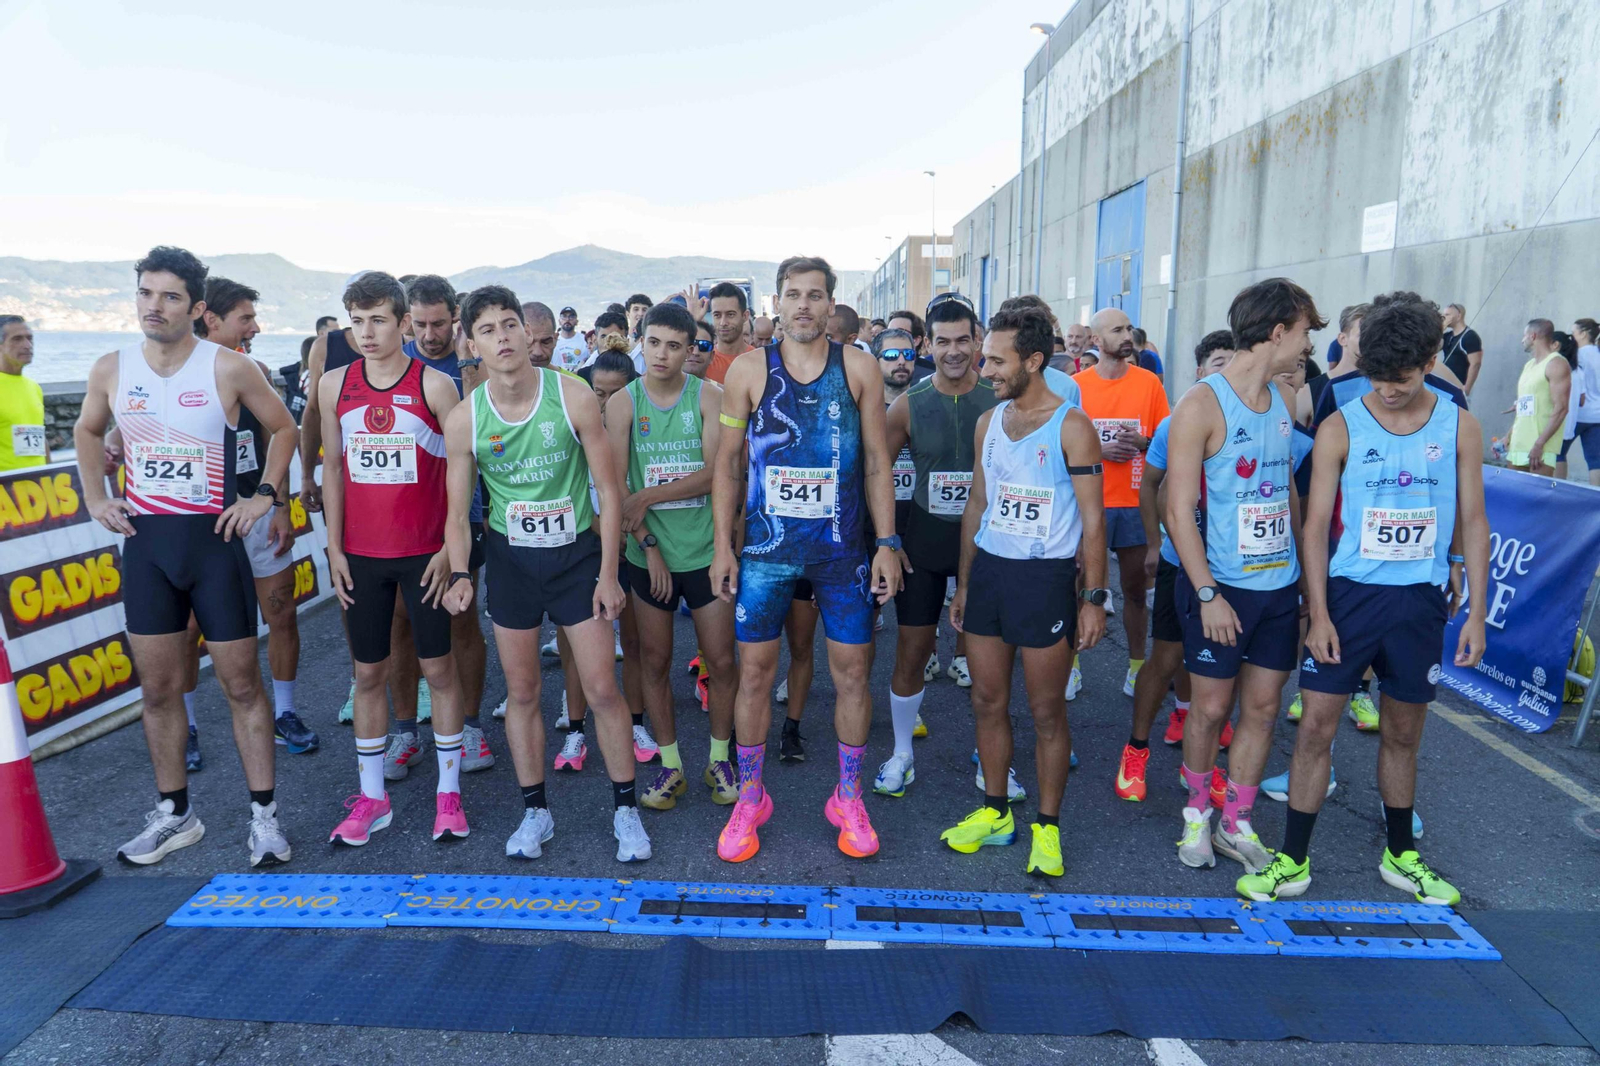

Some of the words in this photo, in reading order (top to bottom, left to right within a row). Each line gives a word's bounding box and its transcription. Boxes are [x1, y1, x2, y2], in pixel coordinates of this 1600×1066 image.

[1101, 430, 1121, 442] 54
[135, 446, 152, 454] 5KM
[154, 446, 173, 454] POR
[175, 447, 204, 456] MAURI
[238, 445, 249, 460] 2
[635, 442, 655, 452] SAN
[360, 450, 402, 468] 501
[487, 462, 514, 472] SAN
[516, 450, 569, 469] MIGUEL
[649, 452, 690, 465] MARÍN
[144, 460, 193, 480] 524
[509, 468, 554, 484] MARÍN
[647, 467, 662, 475] 5KM
[789, 470, 806, 478] POR
[893, 474, 911, 488] 50
[779, 483, 822, 502] 541
[940, 486, 971, 501] 52
[1009, 486, 1023, 495] POR
[1025, 489, 1053, 498] MAURI
[509, 503, 526, 511] 5KM
[1000, 499, 1040, 520] 515
[1242, 507, 1260, 515] 5KM
[1263, 506, 1277, 514] POR
[1367, 511, 1387, 519] 5KM
[1389, 512, 1409, 520] POR
[1411, 510, 1435, 519] MAURI
[521, 513, 565, 534] 611
[1253, 517, 1285, 539] 510
[1377, 525, 1427, 544] 507
[9, 553, 121, 624] GADIS
[16, 641, 133, 722] GADIS
[1504, 675, 1517, 688] en
[1521, 680, 1557, 703] eurobanan
[1518, 689, 1550, 717] Galicia
[676, 886, 775, 896] CRONOTEC
[885, 893, 983, 903] CRONOTEC
[406, 895, 601, 912] CRONOTEC
[1094, 899, 1193, 910] CRONOTEC
[1302, 905, 1402, 915] CRONOTEC
